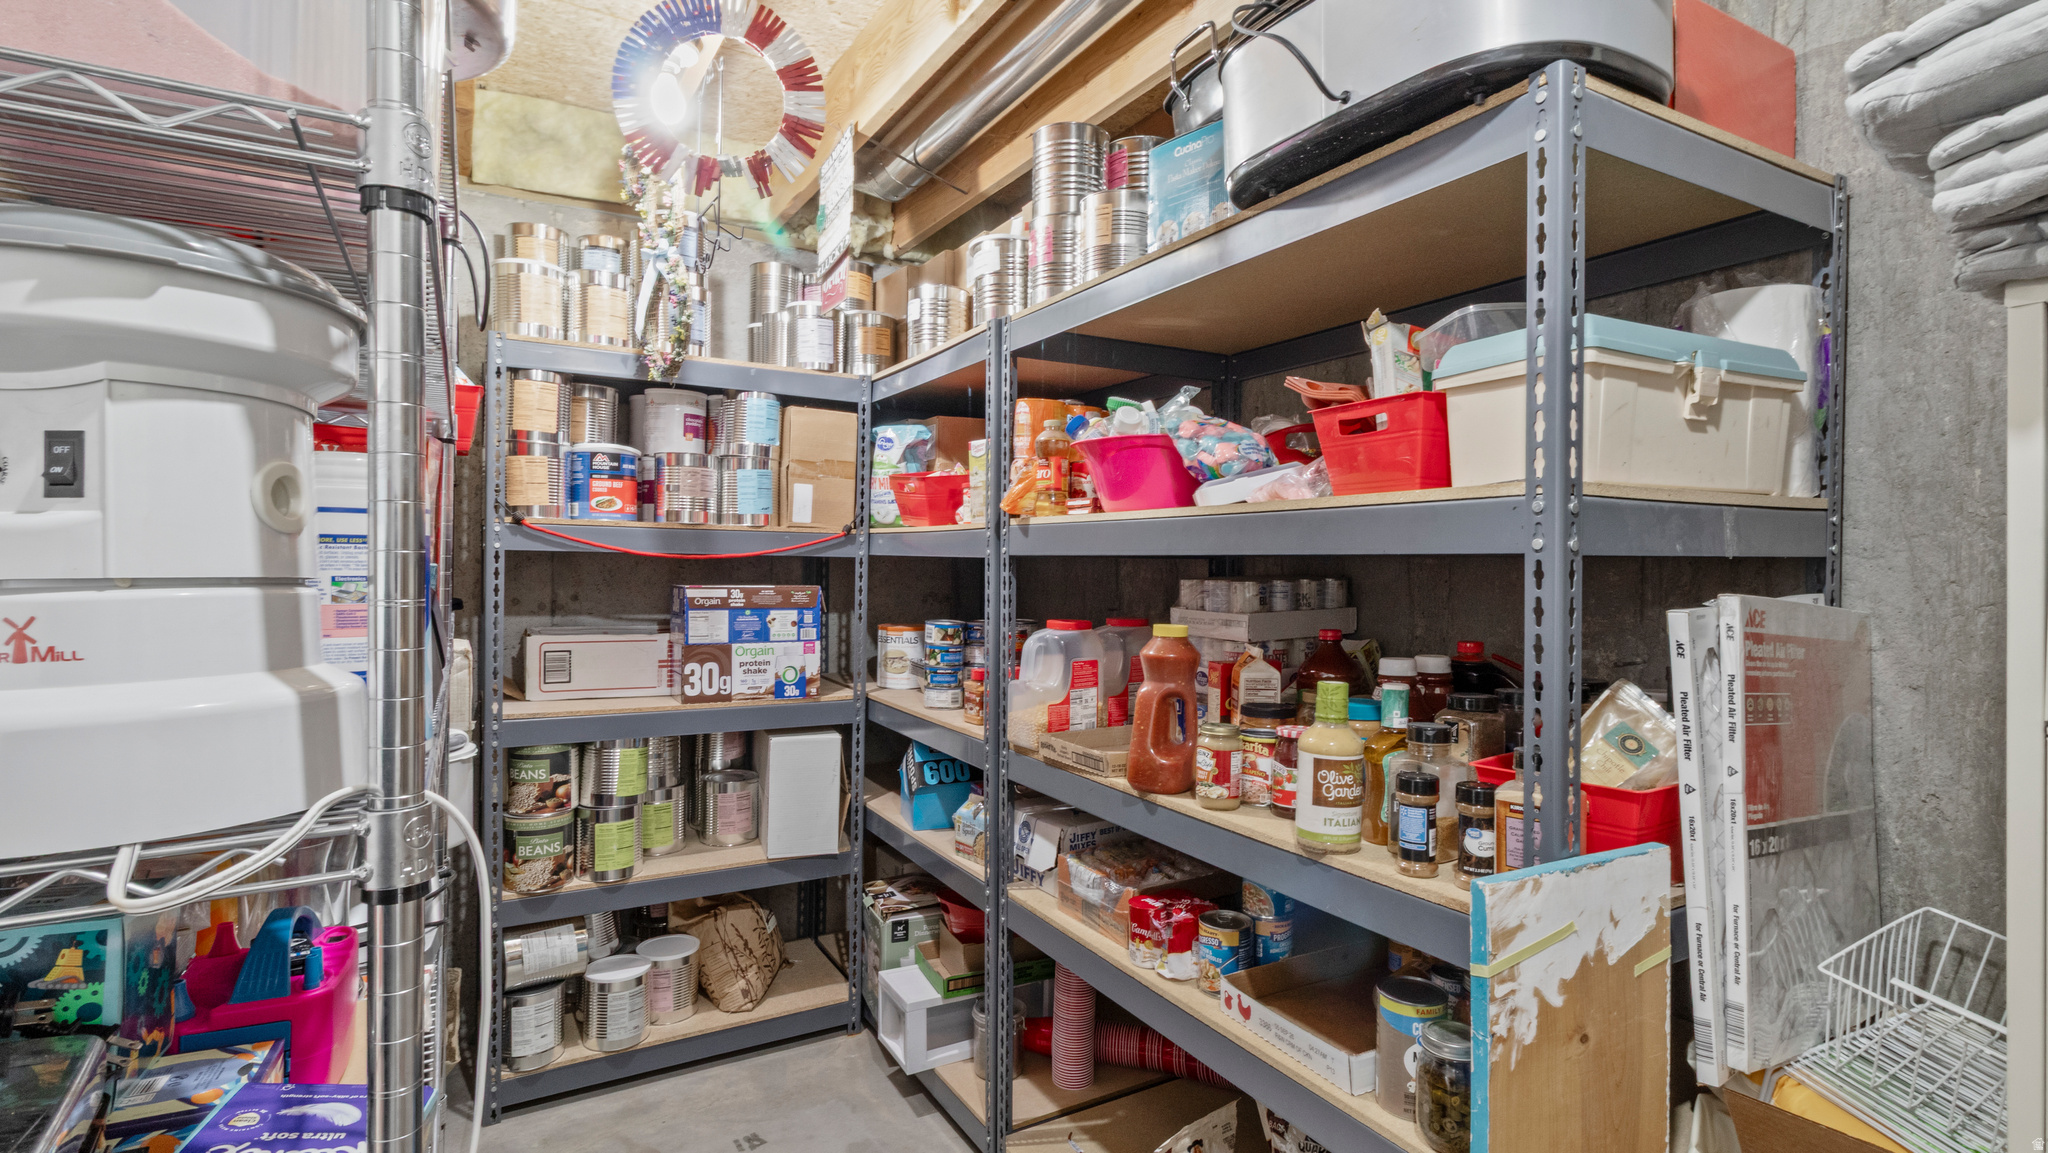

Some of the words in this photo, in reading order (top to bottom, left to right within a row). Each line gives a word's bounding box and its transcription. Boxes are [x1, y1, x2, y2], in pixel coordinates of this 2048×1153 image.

[53, 446, 70, 454] OFF
[592, 480, 612, 488] GROUND
[612, 481, 624, 489] BEEF
[730, 589, 744, 599] 30g
[694, 597, 721, 607] Orgain
[1745, 606, 1767, 629] ACE
[1725, 622, 1735, 642] ACE
[735, 645, 775, 659] Orgain
[1675, 639, 1686, 659] ACE
[1744, 640, 1775, 658] Pleated
[1775, 641, 1787, 659] Air
[1787, 642, 1806, 660] Filter
[739, 659, 771, 669] protein
[742, 667, 768, 675] shake
[683, 660, 732, 697] 30g
[783, 685, 800, 697] 30g
[1727, 673, 1737, 705] Pleated
[1680, 691, 1691, 723] Pleated
[1727, 706, 1737, 720] Air
[1681, 723, 1691, 737] Air
[1728, 720, 1737, 743] Filter
[1682, 737, 1693, 761] Filter
[509, 768, 547, 781] BEANS
[923, 759, 971, 786] 600
[1317, 770, 1354, 785] Olive
[1729, 798, 1738, 825] 16x20x1
[1324, 816, 1361, 828] ITALIAN
[1687, 815, 1697, 842] 16x20x1
[1069, 828, 1098, 844] JIFFY
[1100, 827, 1114, 836] BEST
[517, 841, 562, 857] BEANS
[1013, 857, 1045, 888] JIFFY
[1732, 904, 1740, 914] for
[1694, 922, 1703, 932] for
[1733, 915, 1741, 942] Furnace
[1695, 933, 1705, 959] Furnace
[1733, 951, 1741, 975] Central
[1698, 968, 1706, 992] Central
[1734, 975, 1742, 986] Air
[1699, 992, 1707, 1002] Air
[1416, 1007, 1441, 1016] FAMILY
[260, 1131, 300, 1142] soft
[303, 1131, 347, 1141] ultra
